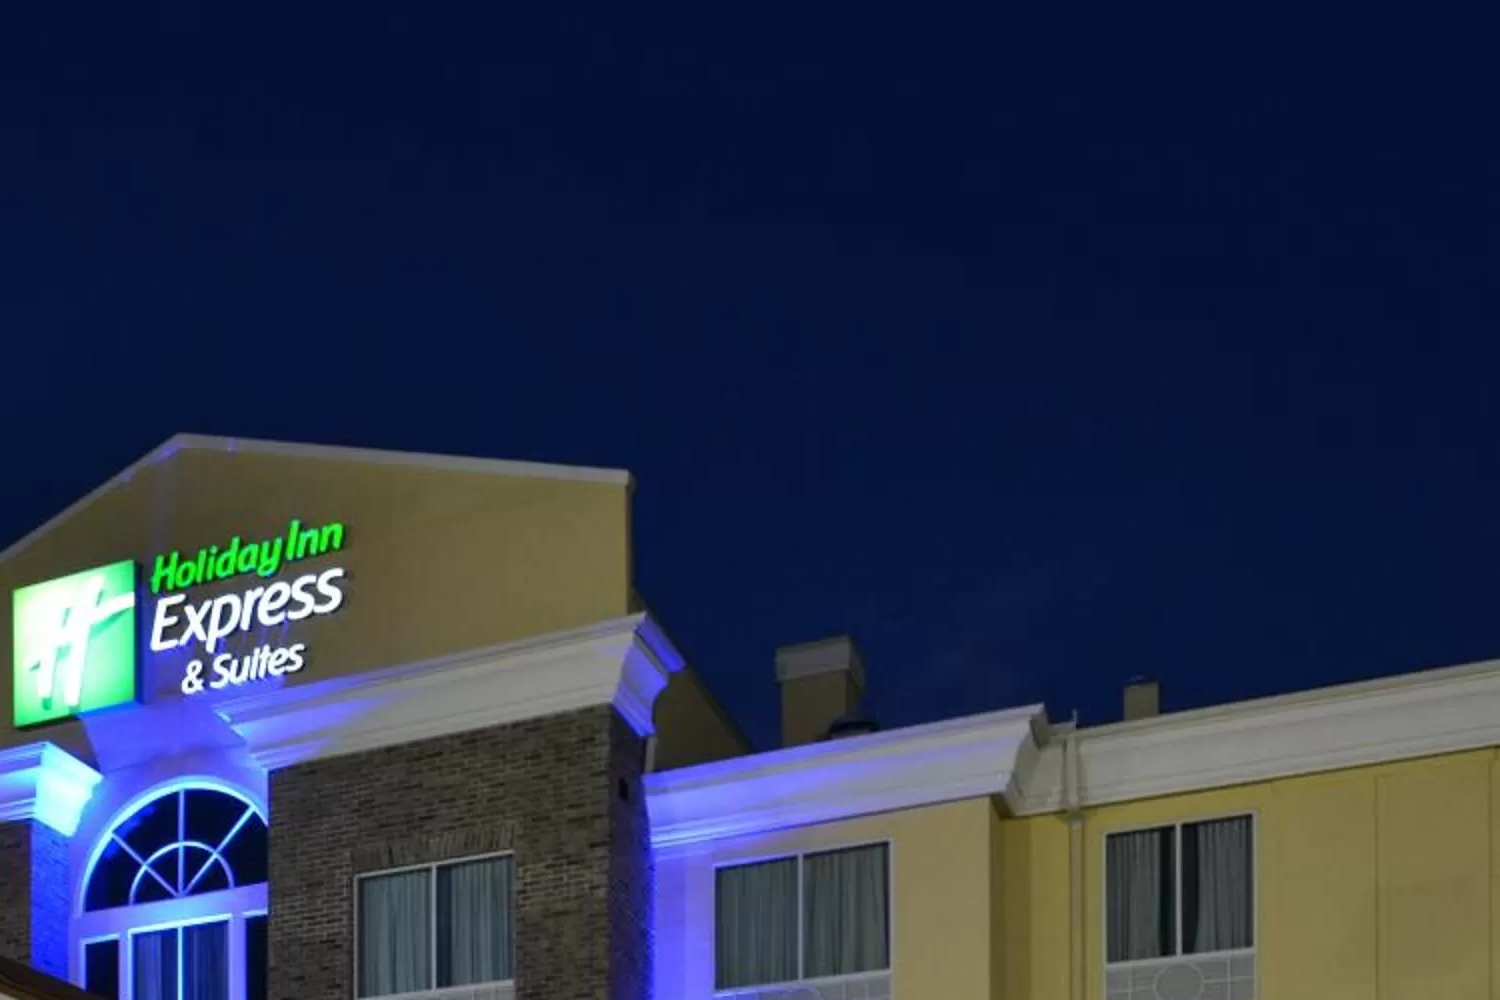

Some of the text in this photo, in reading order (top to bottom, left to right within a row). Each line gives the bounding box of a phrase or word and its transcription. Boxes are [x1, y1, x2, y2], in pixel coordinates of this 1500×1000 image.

[151, 519, 344, 595] Holiday Inn
[150, 567, 345, 654] Express
[181, 642, 305, 695] & Suites
